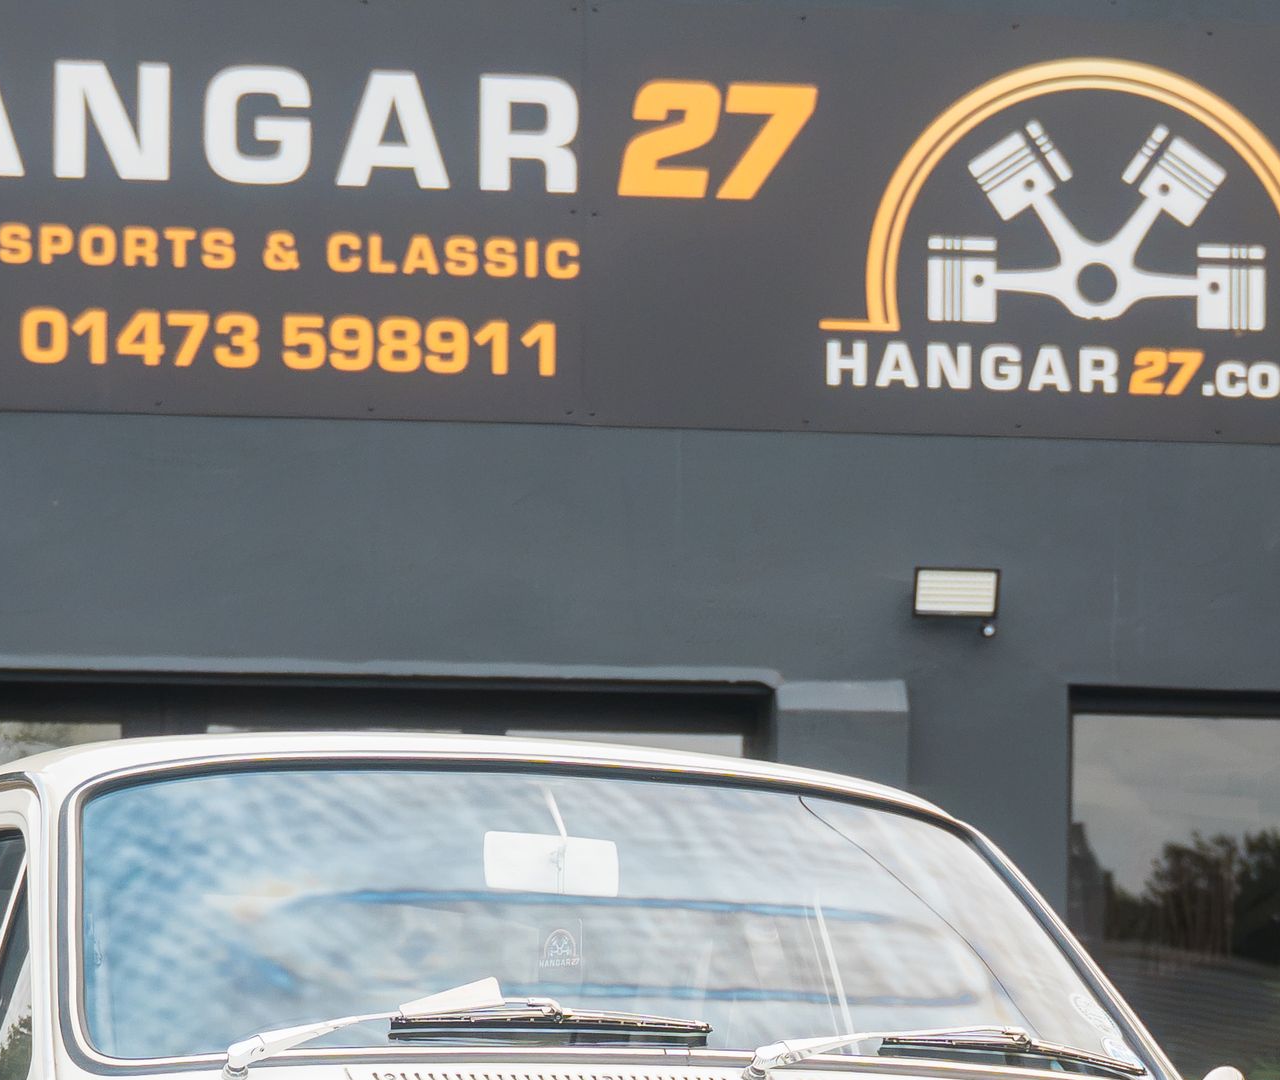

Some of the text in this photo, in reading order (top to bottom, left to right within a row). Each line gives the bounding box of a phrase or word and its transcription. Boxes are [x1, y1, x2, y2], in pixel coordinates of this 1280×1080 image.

[617, 79, 819, 201] 27
[262, 230, 301, 272] &
[326, 231, 581, 280] CLASSIC
[20, 306, 558, 377] 01473 598911
